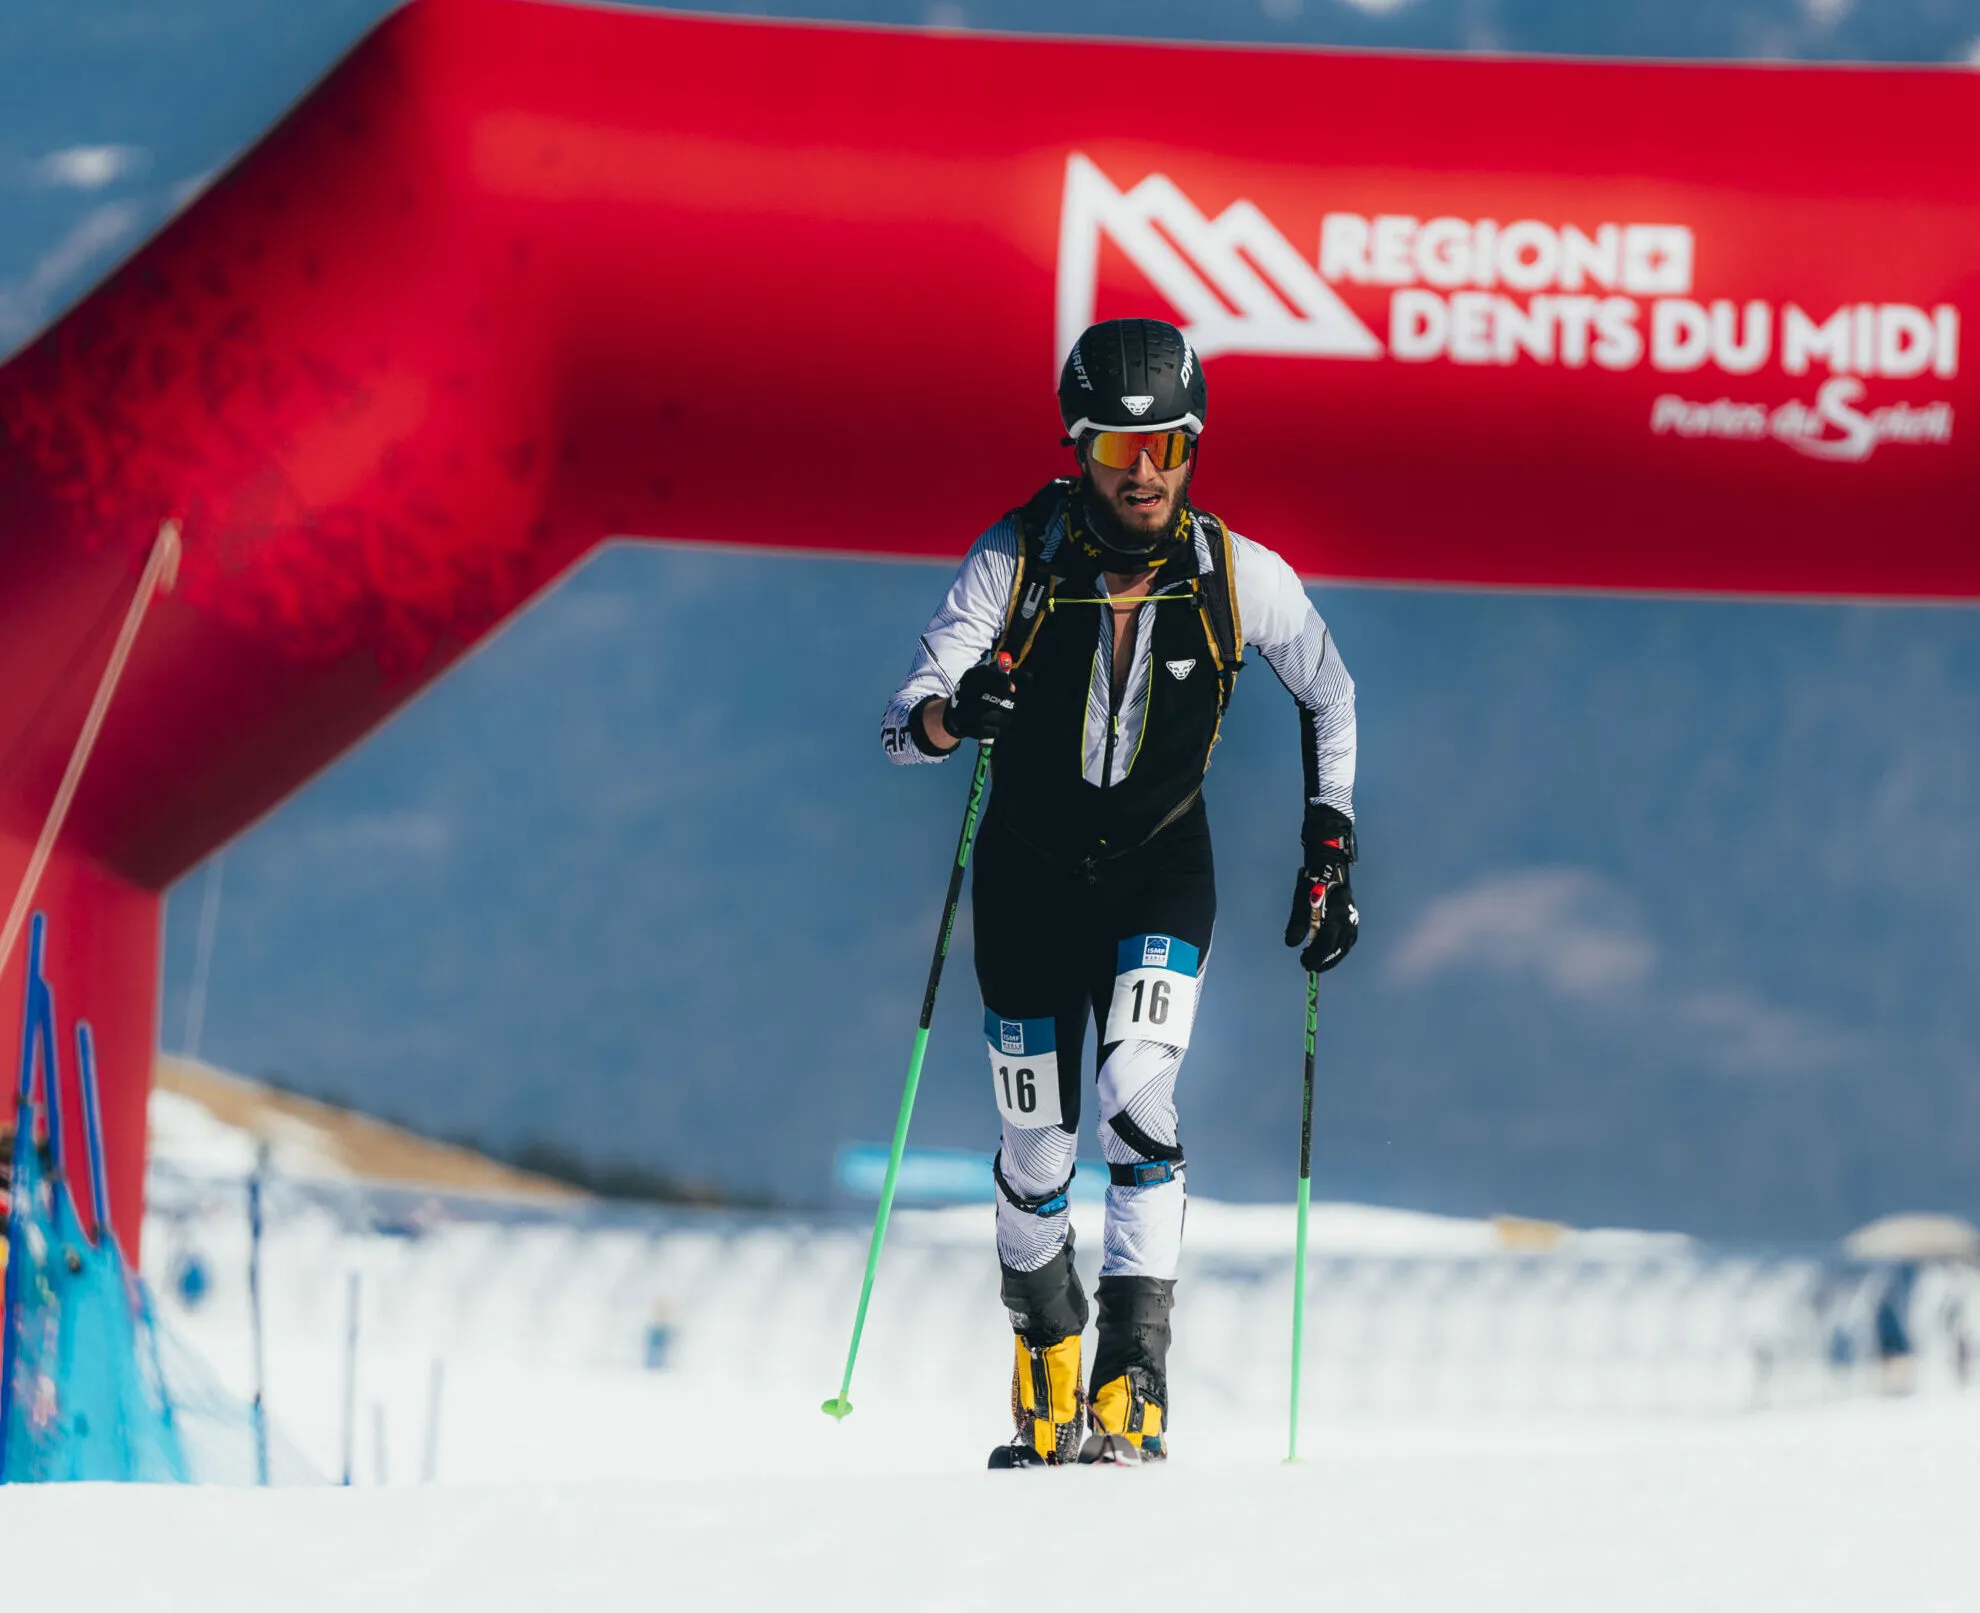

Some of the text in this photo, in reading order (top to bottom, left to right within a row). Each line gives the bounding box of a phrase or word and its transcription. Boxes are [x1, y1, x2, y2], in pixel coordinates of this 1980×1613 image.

[1320, 212, 1620, 289] REGION
[1390, 288, 1960, 381] DENTS DU MIDI
[1131, 979, 1171, 1025] 16
[1003, 1033, 1020, 1041] ISMF
[999, 1065, 1037, 1113] 16
